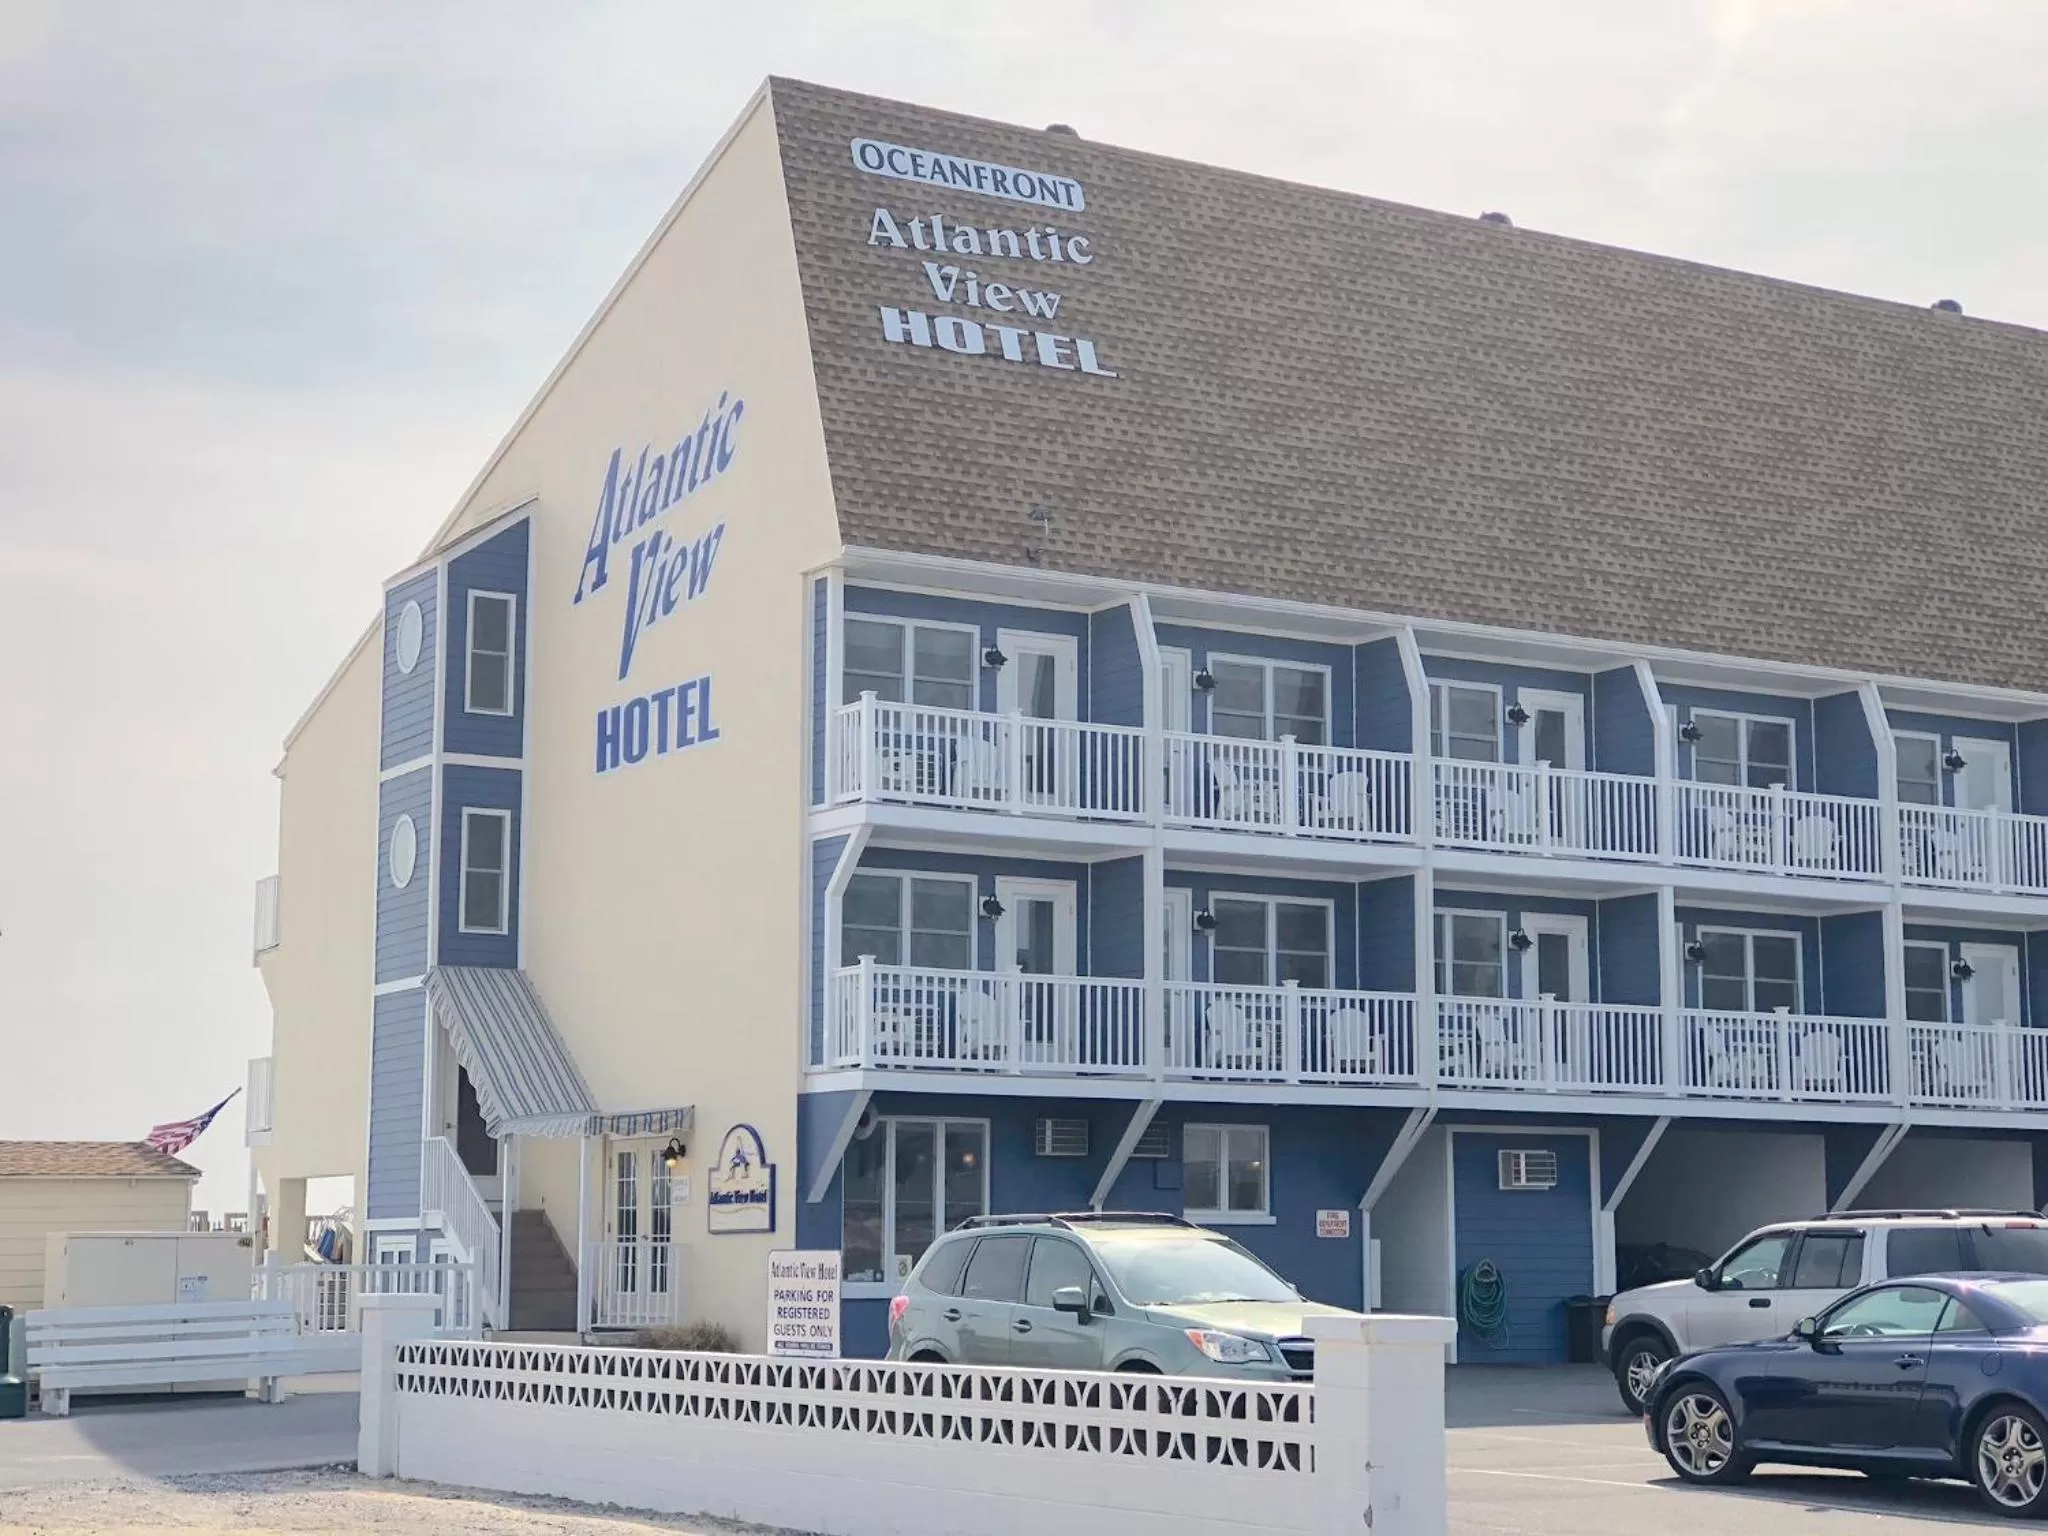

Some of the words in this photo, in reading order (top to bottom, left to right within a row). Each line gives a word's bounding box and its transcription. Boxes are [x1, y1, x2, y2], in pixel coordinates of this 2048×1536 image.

[859, 143, 1075, 207] OCEANFRONT
[867, 208, 1093, 264] Atlantic
[922, 260, 1062, 319] View
[880, 306, 1119, 377] HOTEL
[573, 390, 744, 604] Atlantic
[618, 523, 726, 681] View
[596, 676, 720, 773] HOTEL
[771, 1261, 799, 1278] Atlantic
[800, 1262, 817, 1279] View
[818, 1262, 838, 1280] Hotel
[774, 1289, 813, 1302] PARKING
[817, 1290, 834, 1302] FOR
[774, 1323, 806, 1337] GUESTS
[809, 1324, 833, 1337] ONLY
[777, 1306, 831, 1320] REGISTERED
